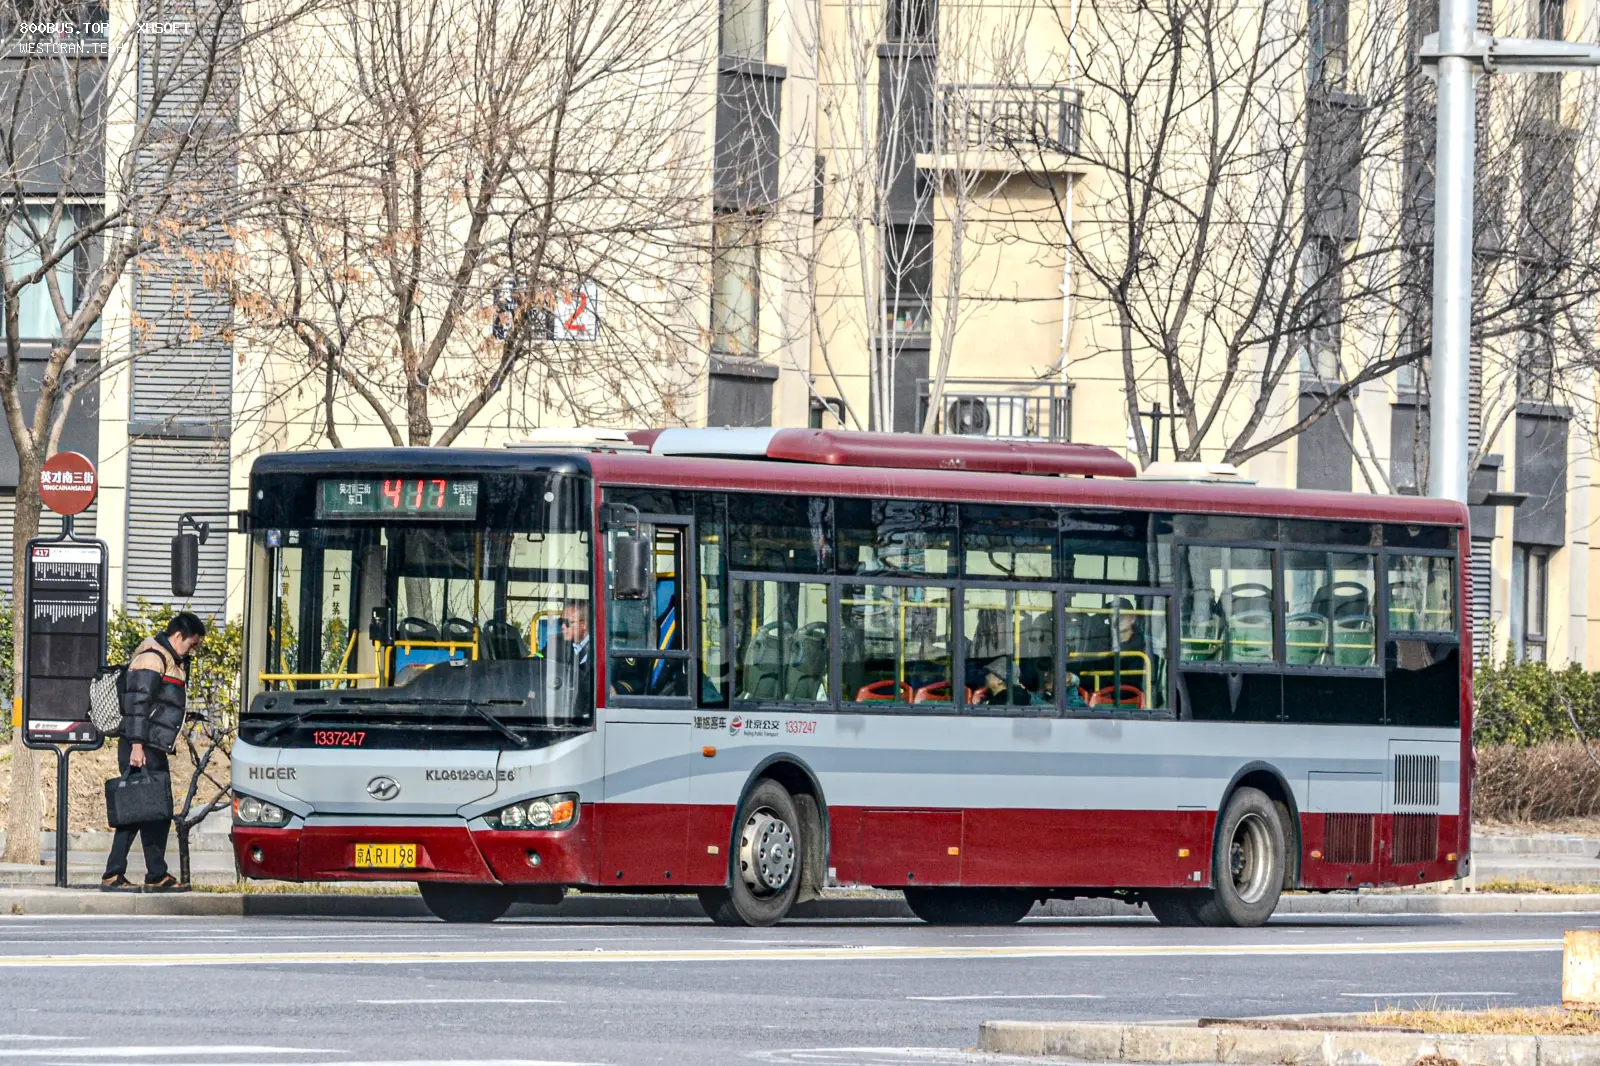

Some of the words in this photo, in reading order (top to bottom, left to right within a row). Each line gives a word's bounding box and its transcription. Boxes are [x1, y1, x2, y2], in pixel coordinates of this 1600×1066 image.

[563, 290, 587, 330] 2
[41, 471, 94, 483] 英才南三街
[384, 480, 446, 508] 417
[35, 549, 48, 557] 417
[745, 719, 780, 730] 北京公交
[785, 721, 817, 734] 1337247
[313, 731, 366, 746] 1337247
[249, 767, 296, 780] HIGER
